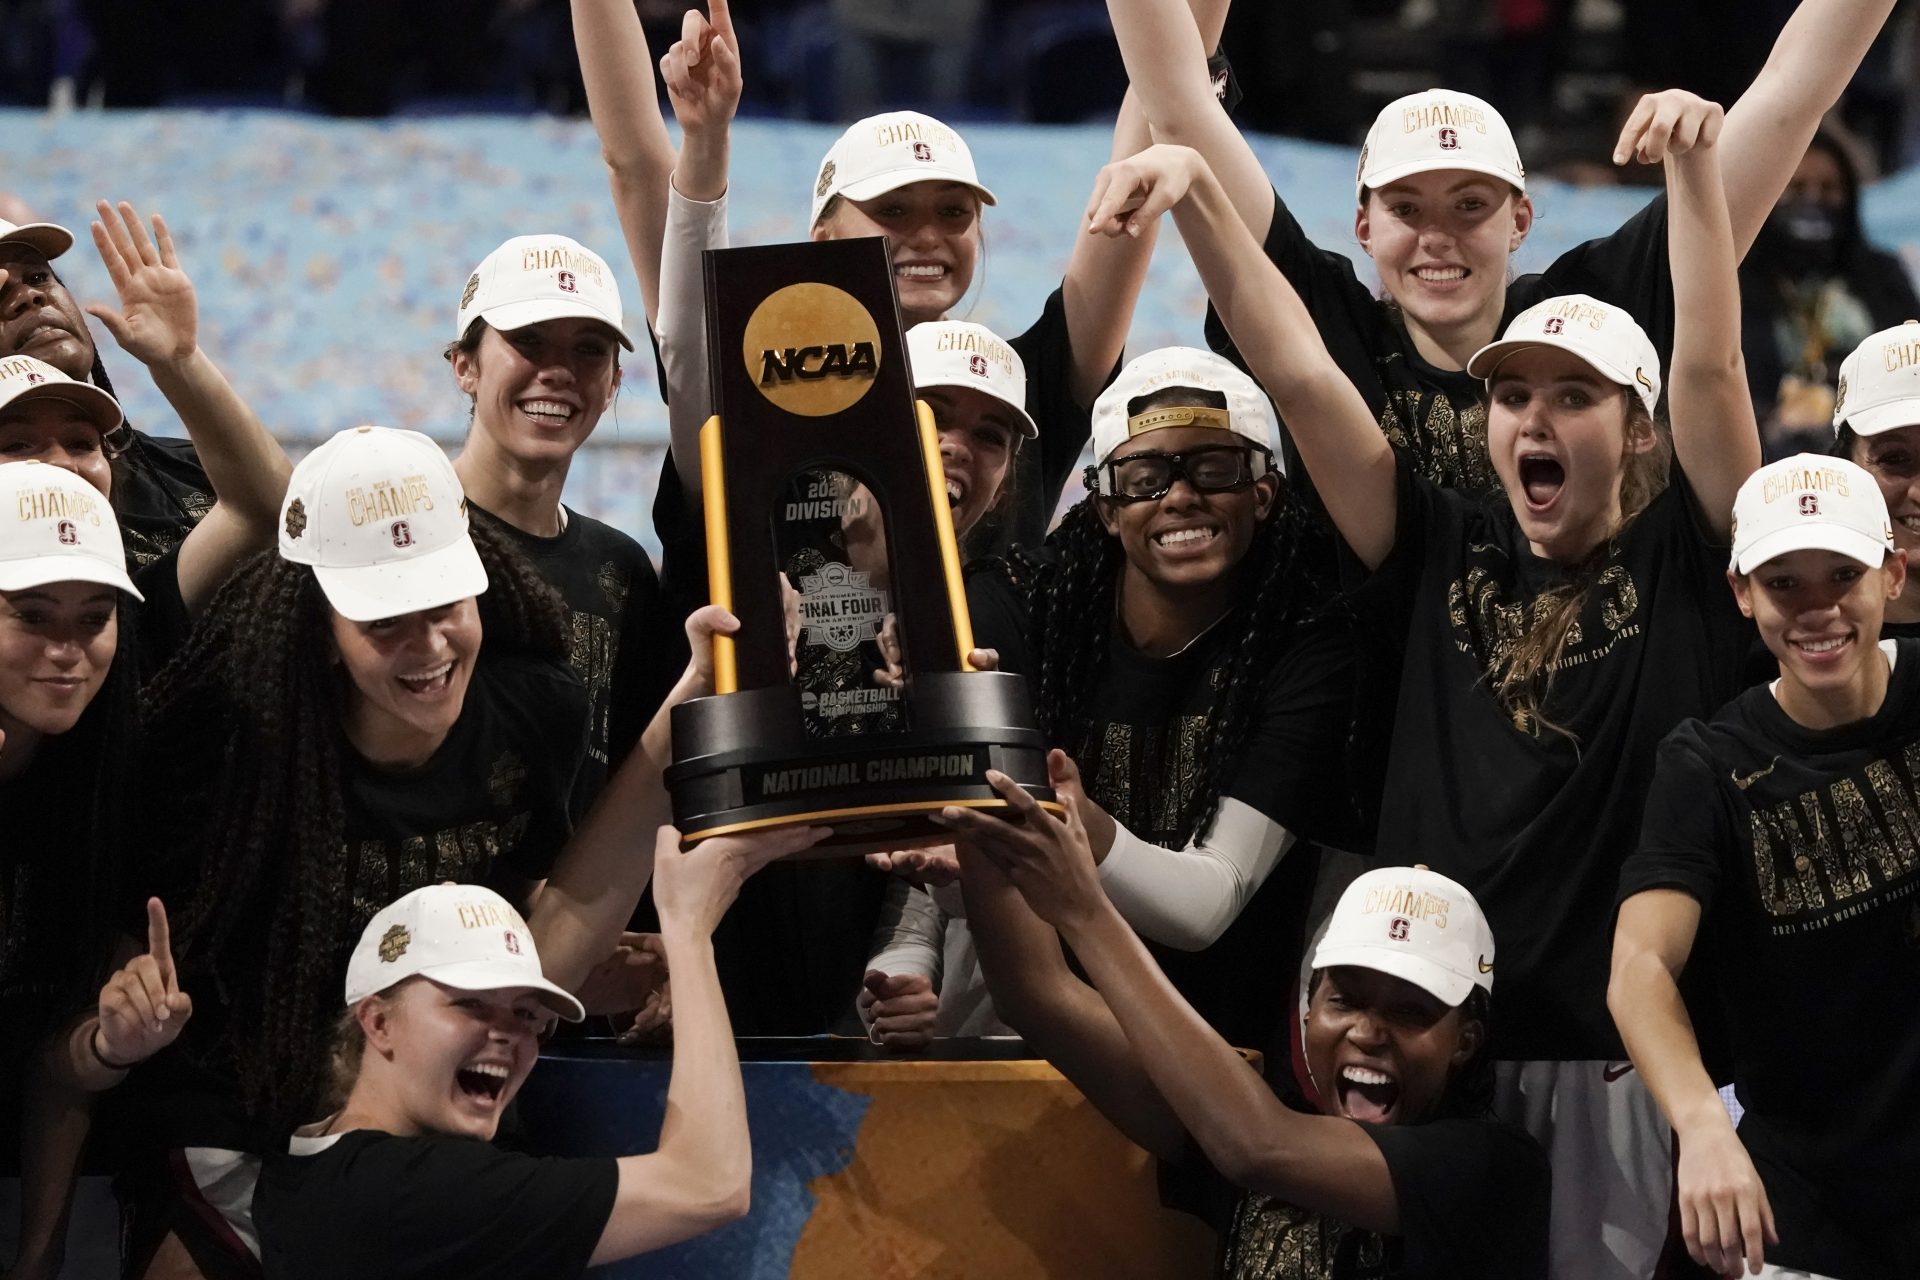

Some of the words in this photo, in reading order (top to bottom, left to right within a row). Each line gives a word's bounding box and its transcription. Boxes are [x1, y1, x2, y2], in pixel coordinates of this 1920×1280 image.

[1403, 105, 1486, 134] CHAMPS
[760, 341, 878, 383] NCAA
[1763, 470, 1849, 505] CHAMPS
[19, 493, 101, 527] CHAMPS
[348, 483, 434, 527] CHAMPS
[786, 499, 861, 521] DIVISION
[832, 615, 865, 623] ANTONIO
[841, 597, 882, 615] FOUR
[1545, 652, 1588, 673] NATIONAL
[820, 687, 900, 707] BASKETBALL
[820, 702, 888, 718] CHAMPIONSHIP
[762, 762, 860, 795] NATIONAL
[866, 754, 974, 782] CHAMPION
[1361, 887, 1449, 928] CHAMPS
[1772, 924, 1796, 936] 2021
[1802, 916, 1829, 931] NCAA
[1834, 897, 1879, 922] WOMEN'S
